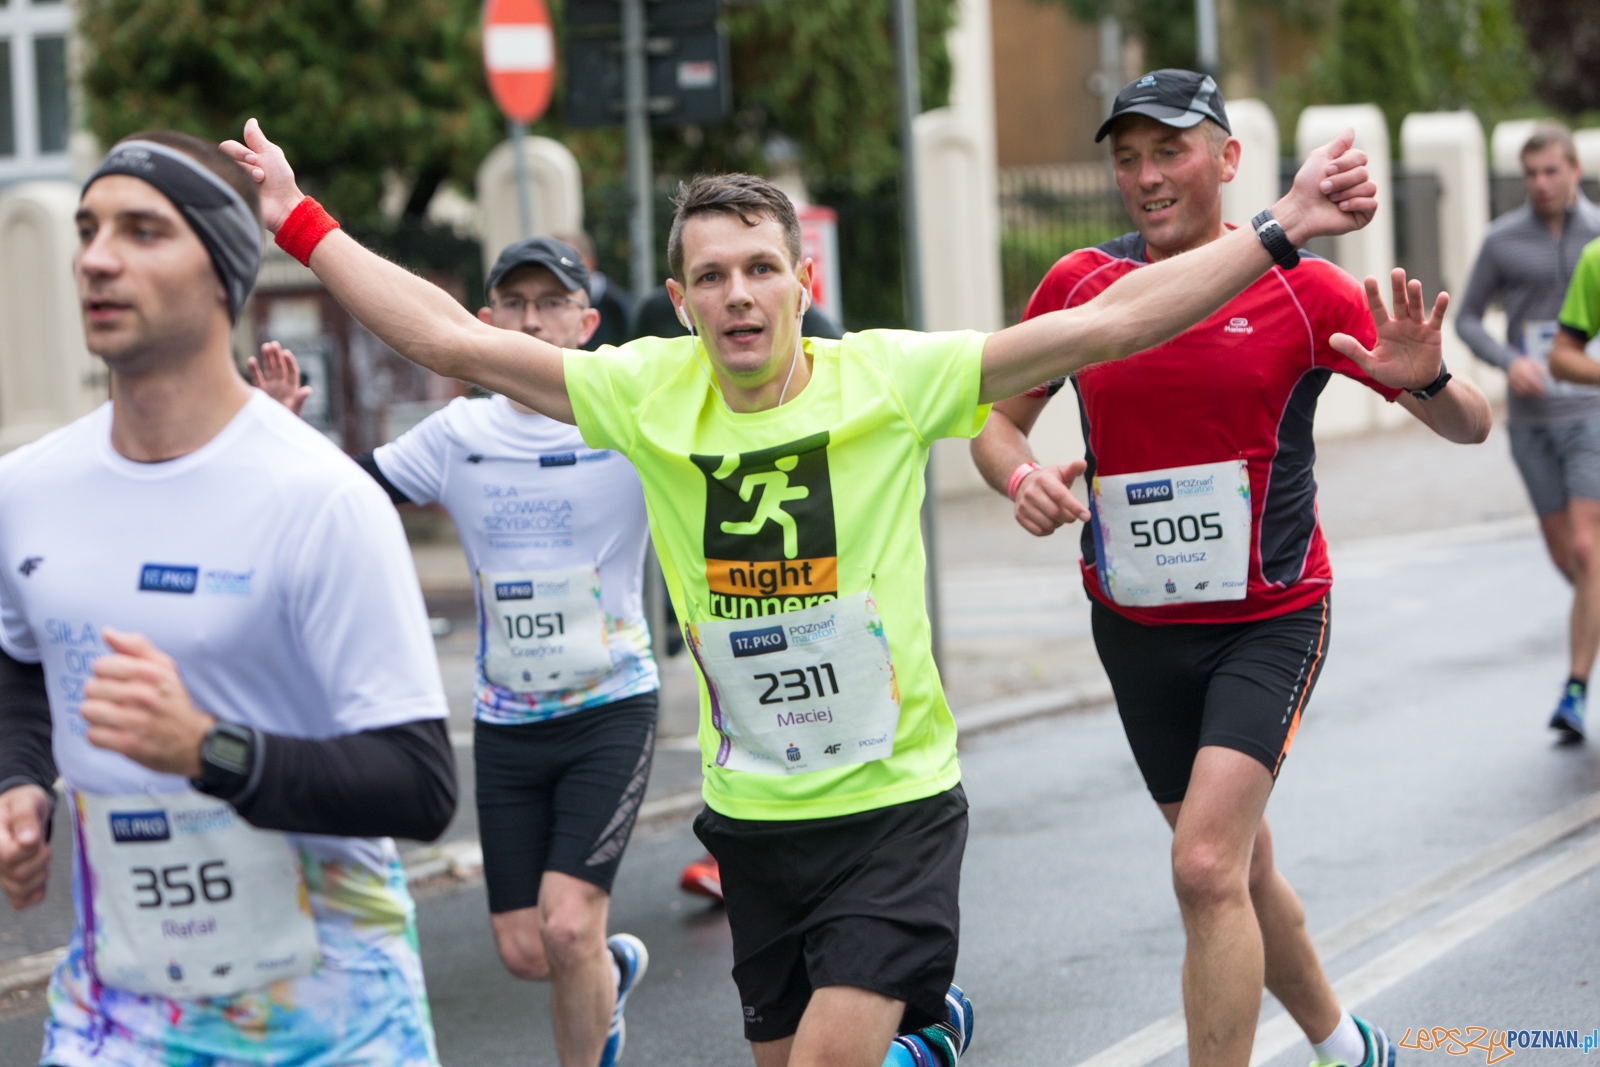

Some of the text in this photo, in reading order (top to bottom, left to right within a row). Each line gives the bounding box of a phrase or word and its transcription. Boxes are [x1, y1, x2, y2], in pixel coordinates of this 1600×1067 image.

[1130, 485, 1170, 500] 17.PKO
[492, 500, 573, 514] ODWAGA
[1130, 512, 1223, 548] 5005
[1156, 552, 1207, 566] Dariusz
[729, 562, 813, 595] night
[504, 612, 565, 640] 1051
[735, 633, 782, 650] 17.PKO
[792, 627, 837, 644] maraton
[753, 663, 839, 705] 2311
[777, 707, 833, 727] Maciej
[823, 743, 842, 755] 4F
[131, 861, 233, 908] 356
